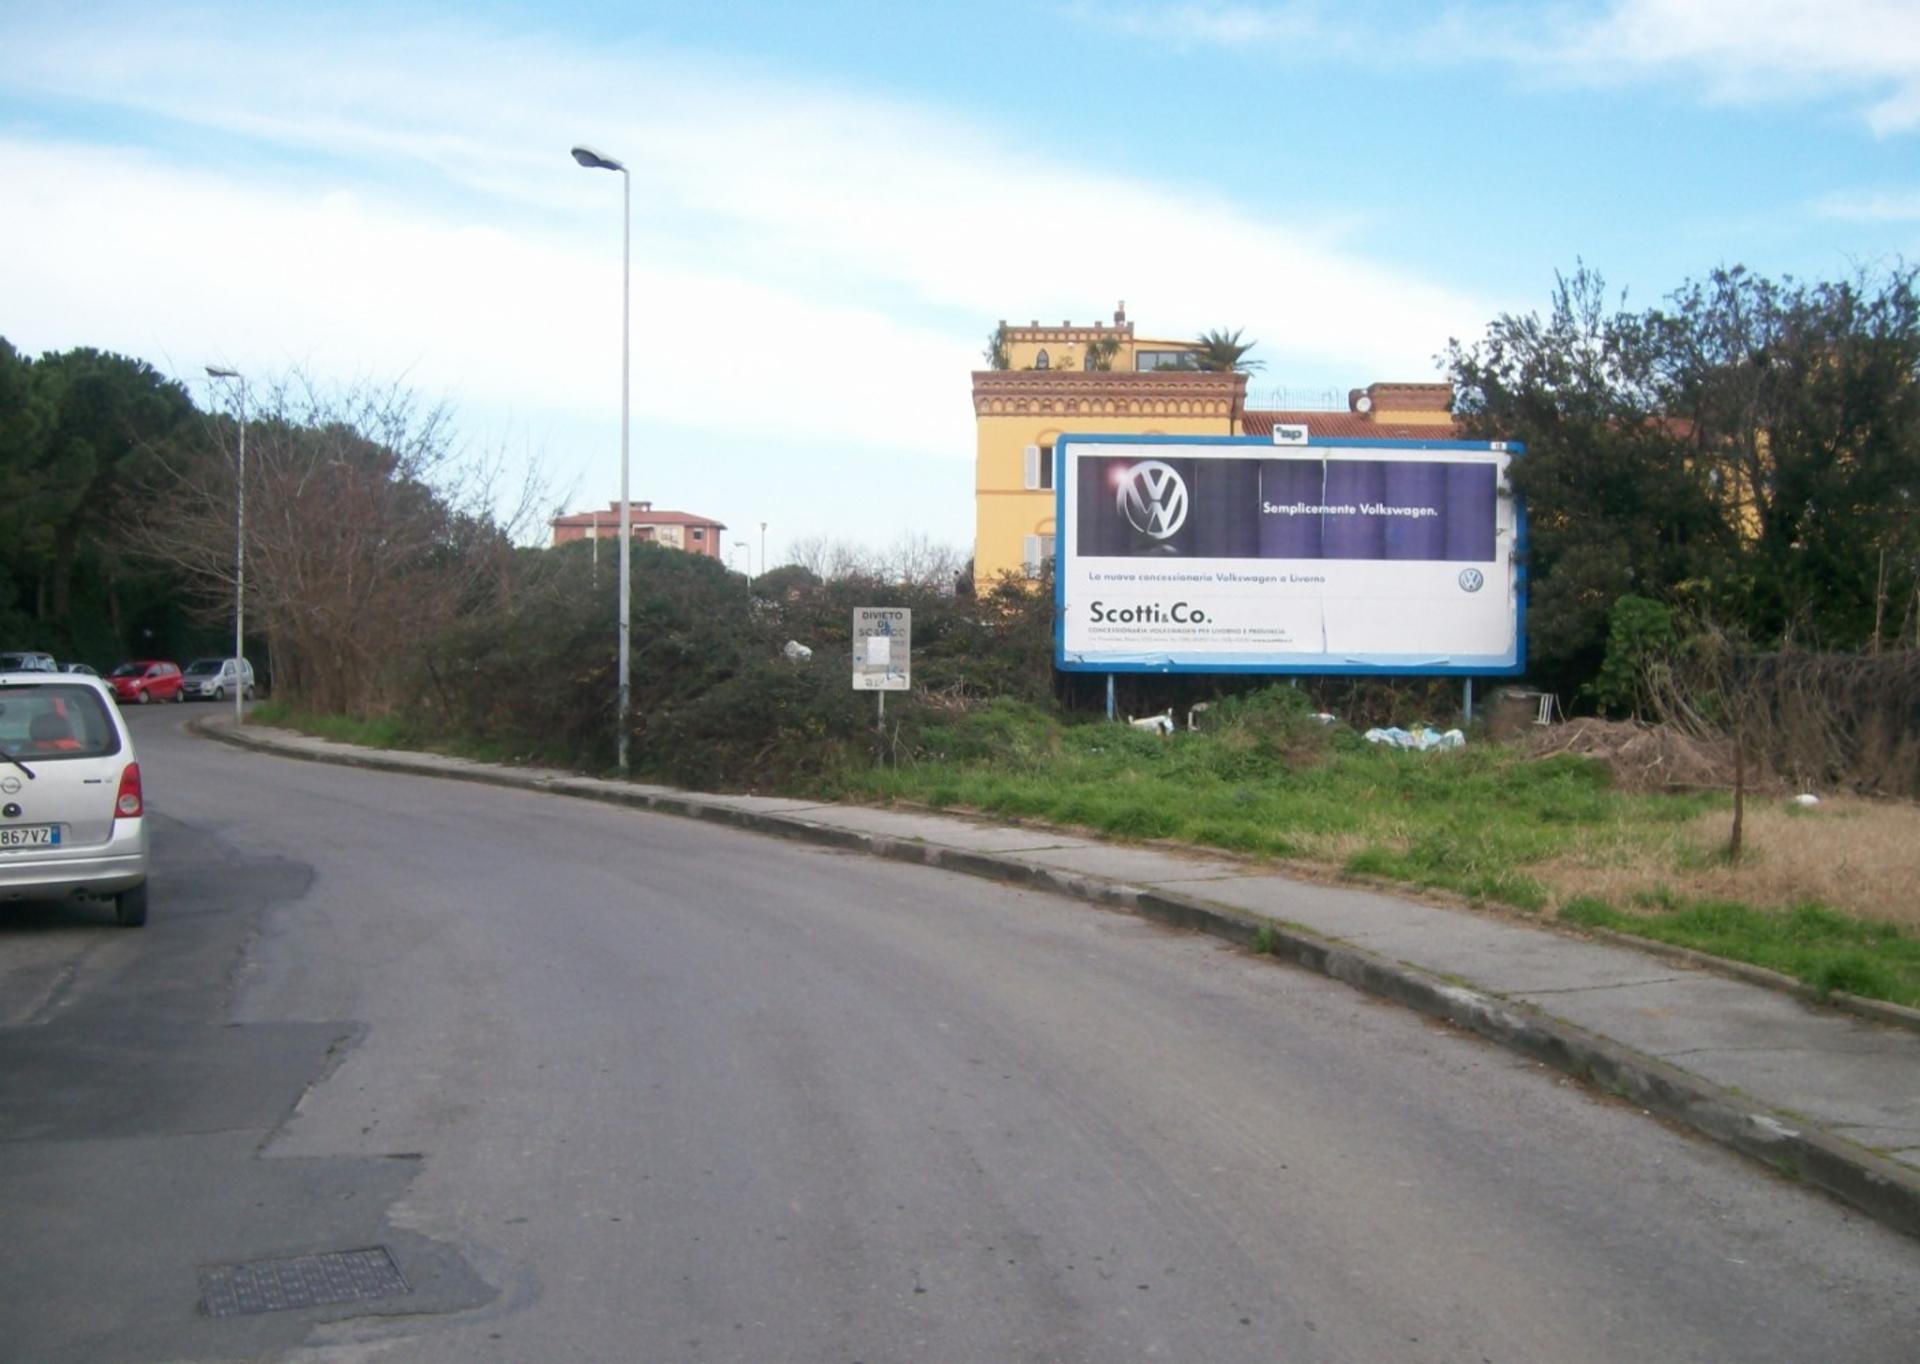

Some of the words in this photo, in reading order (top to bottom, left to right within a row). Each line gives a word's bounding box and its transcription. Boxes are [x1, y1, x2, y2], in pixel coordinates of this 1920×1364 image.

[1263, 502, 1356, 516] Semplicemente
[1360, 503, 1438, 518] Volkswagen.
[1088, 572, 1102, 581] La
[1139, 573, 1213, 582] concessionaria
[1216, 573, 1278, 584] Volkswagen
[1290, 574, 1326, 583] Livorno
[862, 611, 904, 621] DIVIETO
[1088, 626, 1148, 634] CONCESSIONARIA
[0, 829, 49, 845] 867VZ
